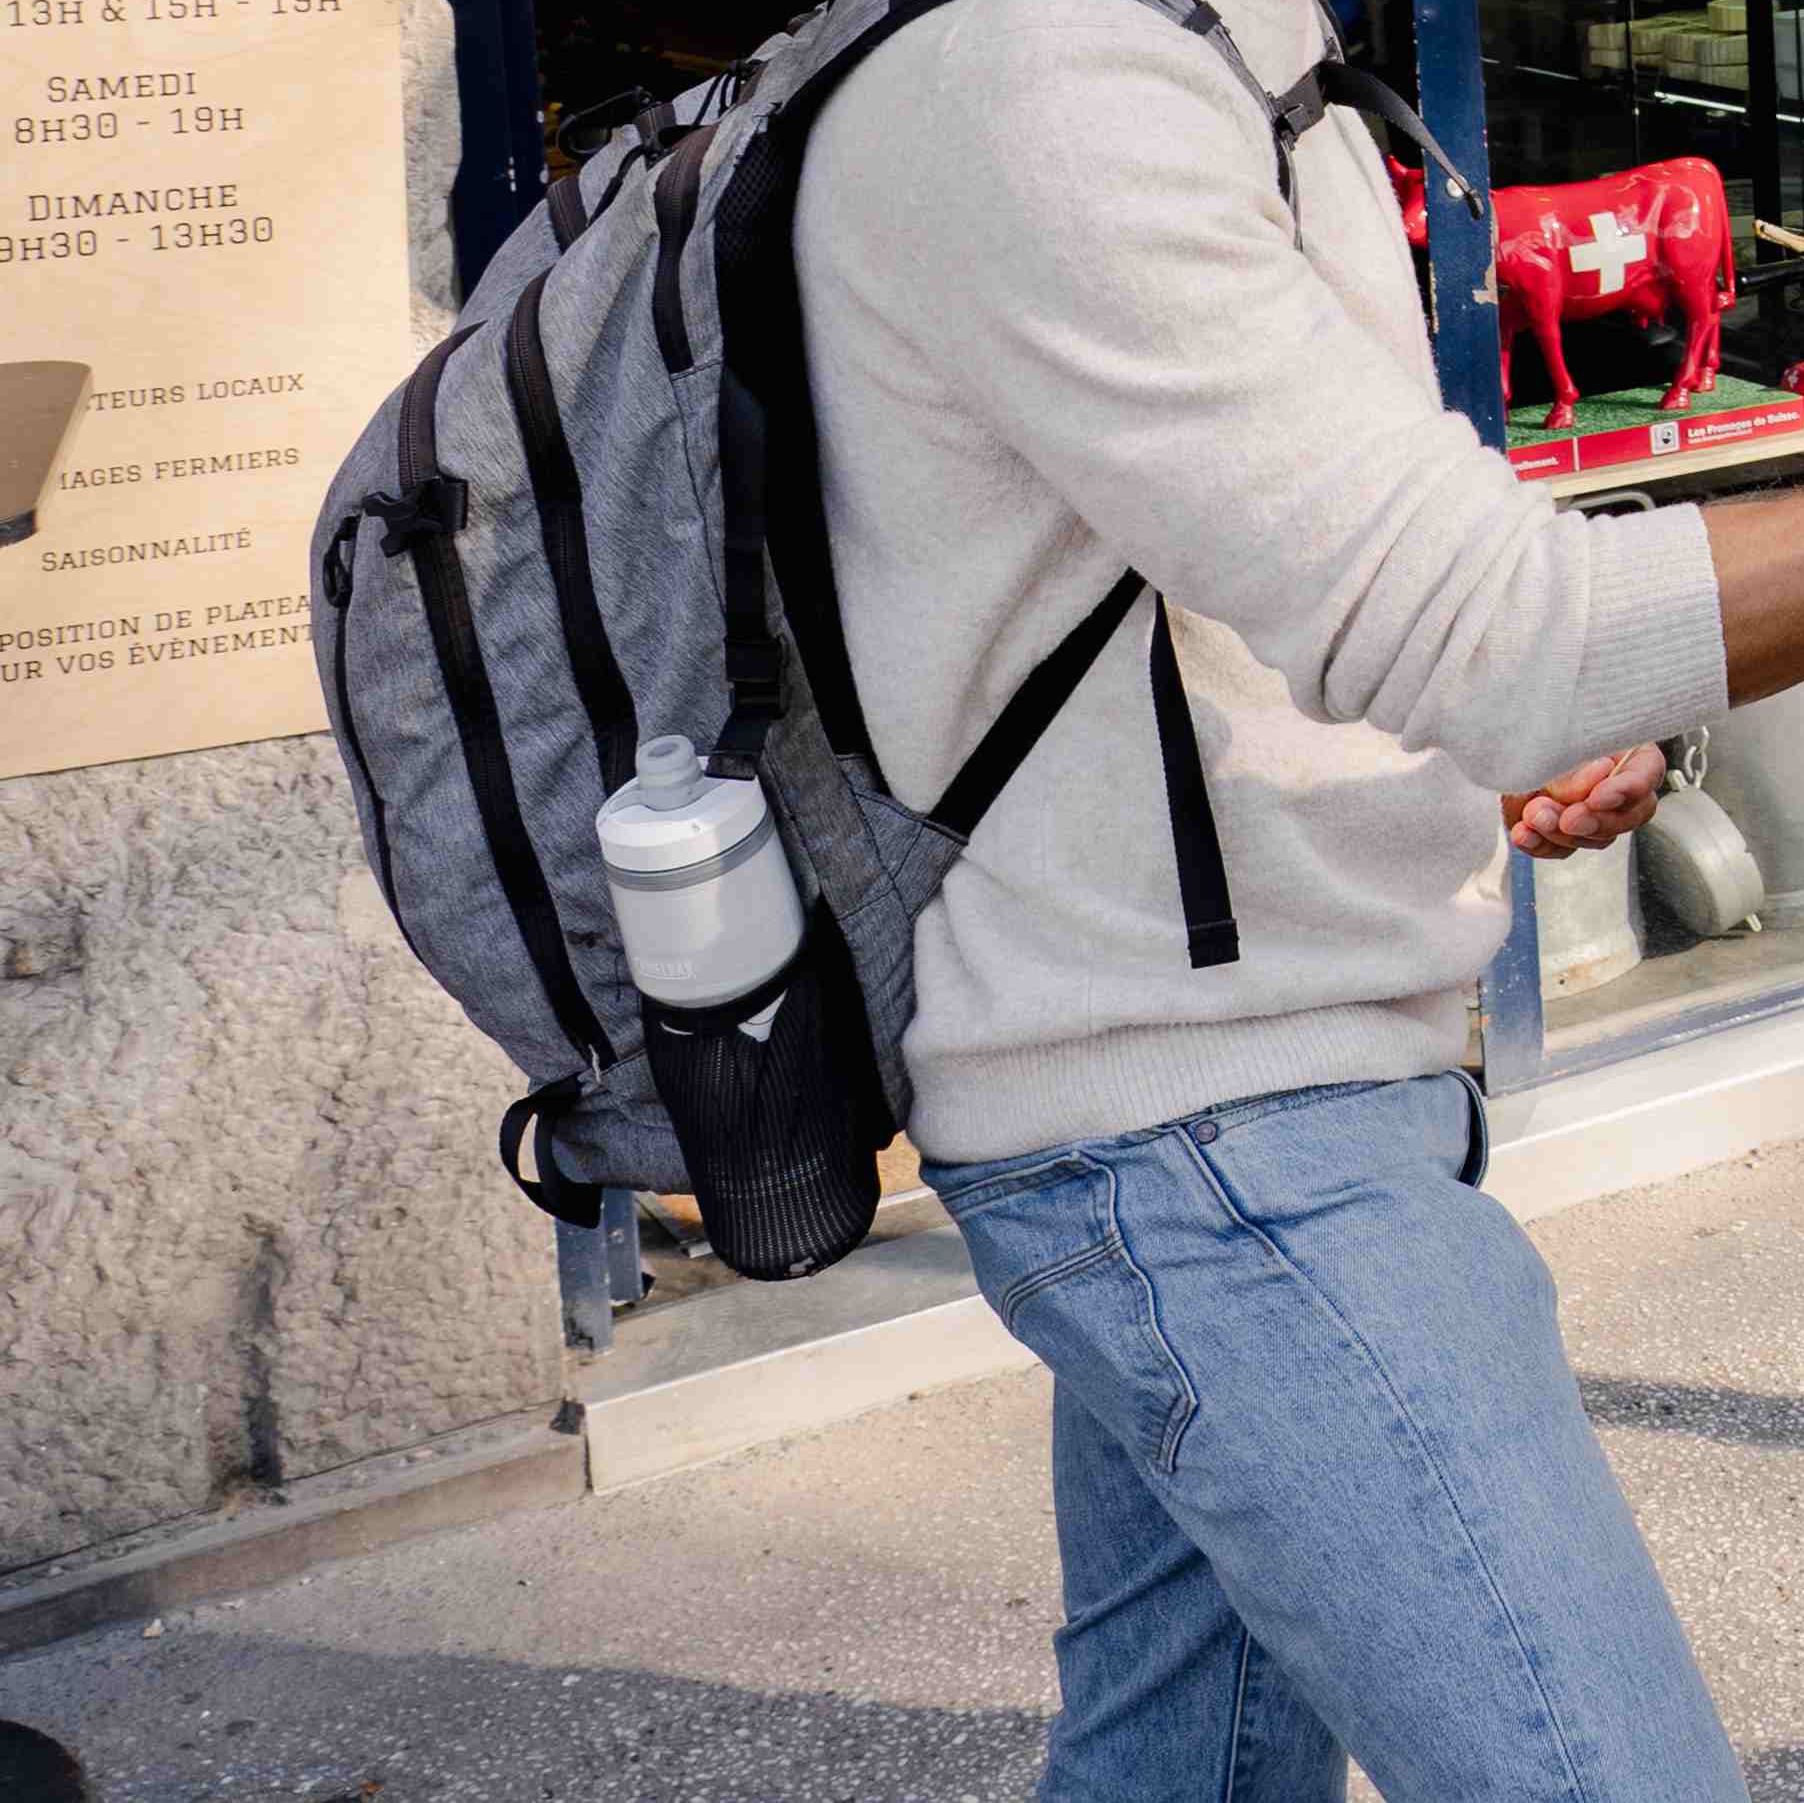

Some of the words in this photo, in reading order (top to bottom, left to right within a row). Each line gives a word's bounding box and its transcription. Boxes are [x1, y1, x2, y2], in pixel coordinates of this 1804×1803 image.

[6, 0, 85, 28] 13H
[46, 71, 198, 104] SAMEDI
[14, 111, 119, 145] 8H30
[172, 105, 245, 135] 19H
[28, 183, 239, 223] DIMANCHE
[151, 216, 275, 252] 13H30
[85, 384, 186, 412] TEURS
[198, 372, 306, 402] LOCAUX
[155, 447, 301, 481] FERMIERS
[41, 527, 253, 573] SAISONNALITÉ
[155, 609, 193, 633] DE
[57, 649, 116, 675] VOS
